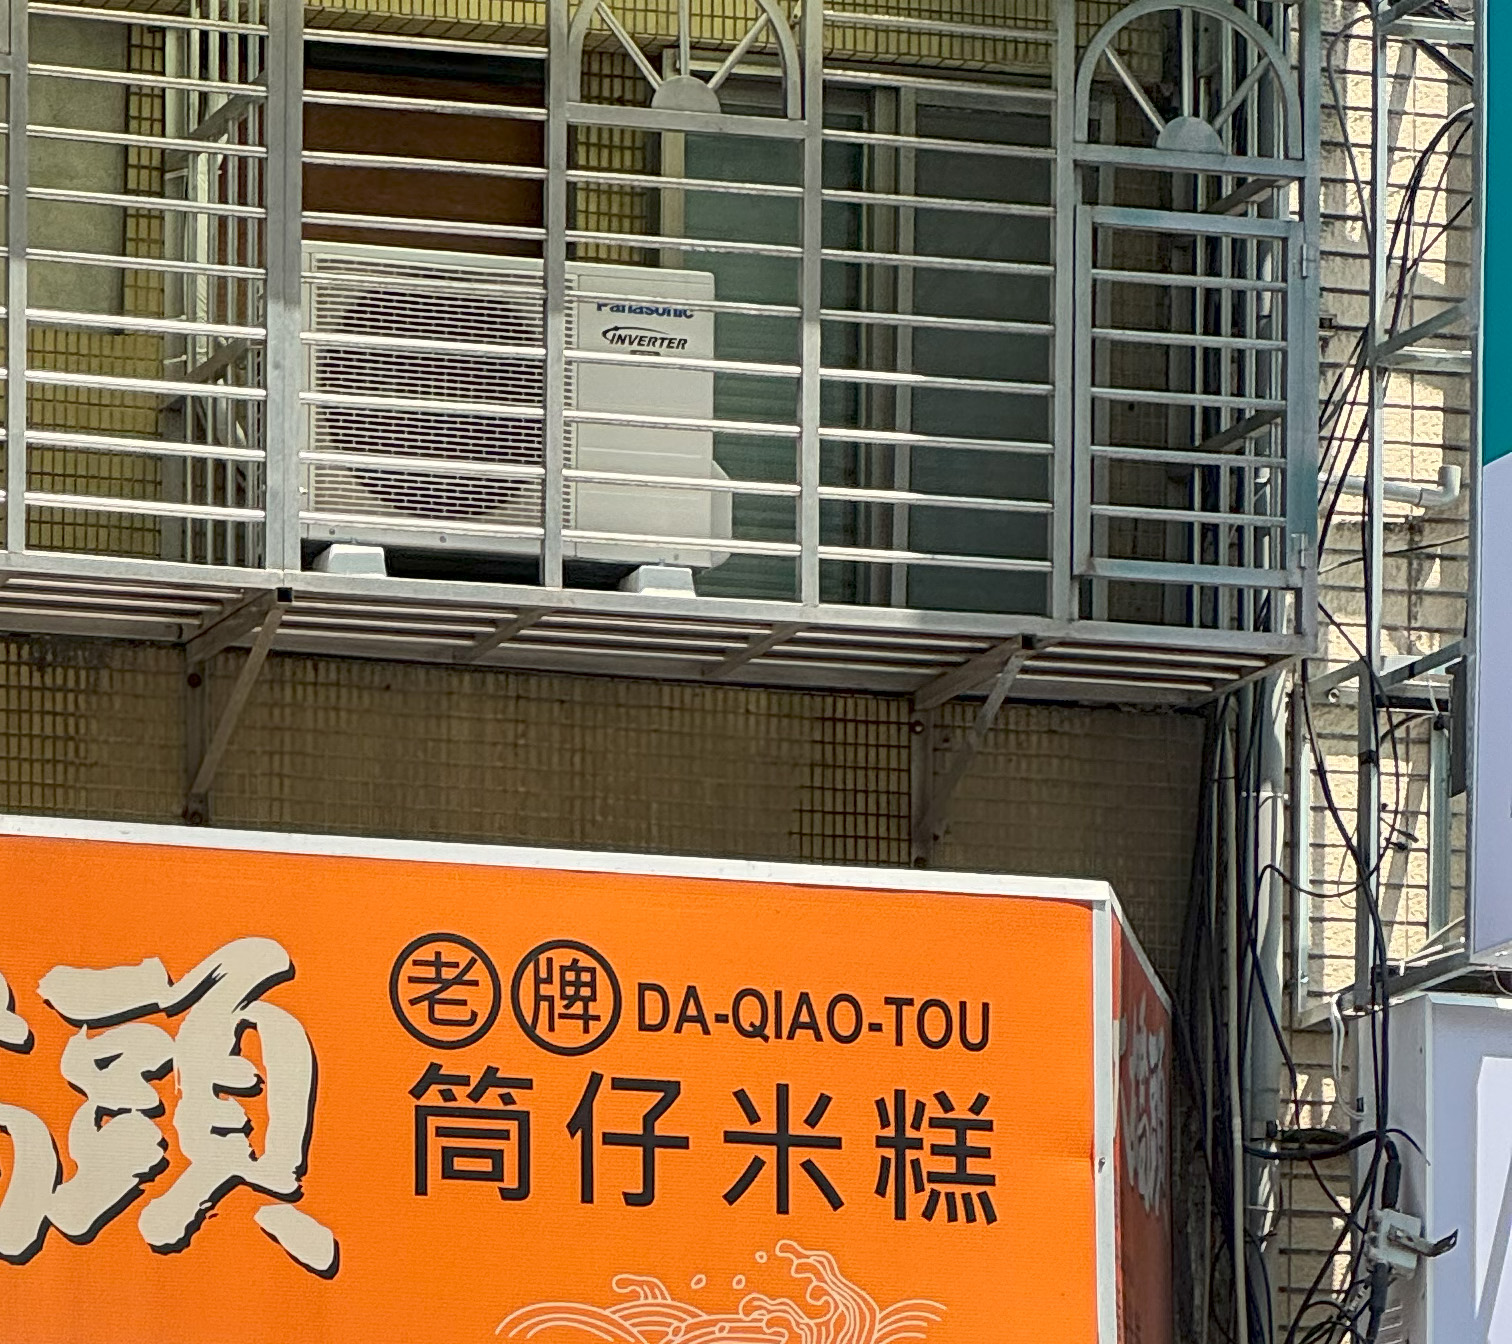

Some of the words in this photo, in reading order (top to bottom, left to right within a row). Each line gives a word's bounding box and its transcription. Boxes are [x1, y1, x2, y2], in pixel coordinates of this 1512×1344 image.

[609, 332, 688, 350] INVERTER
[389, 932, 622, 1057] 老牌
[637, 982, 992, 1053] DA-QIAO-TOU
[407, 1061, 999, 1227] 筒仔米糕
